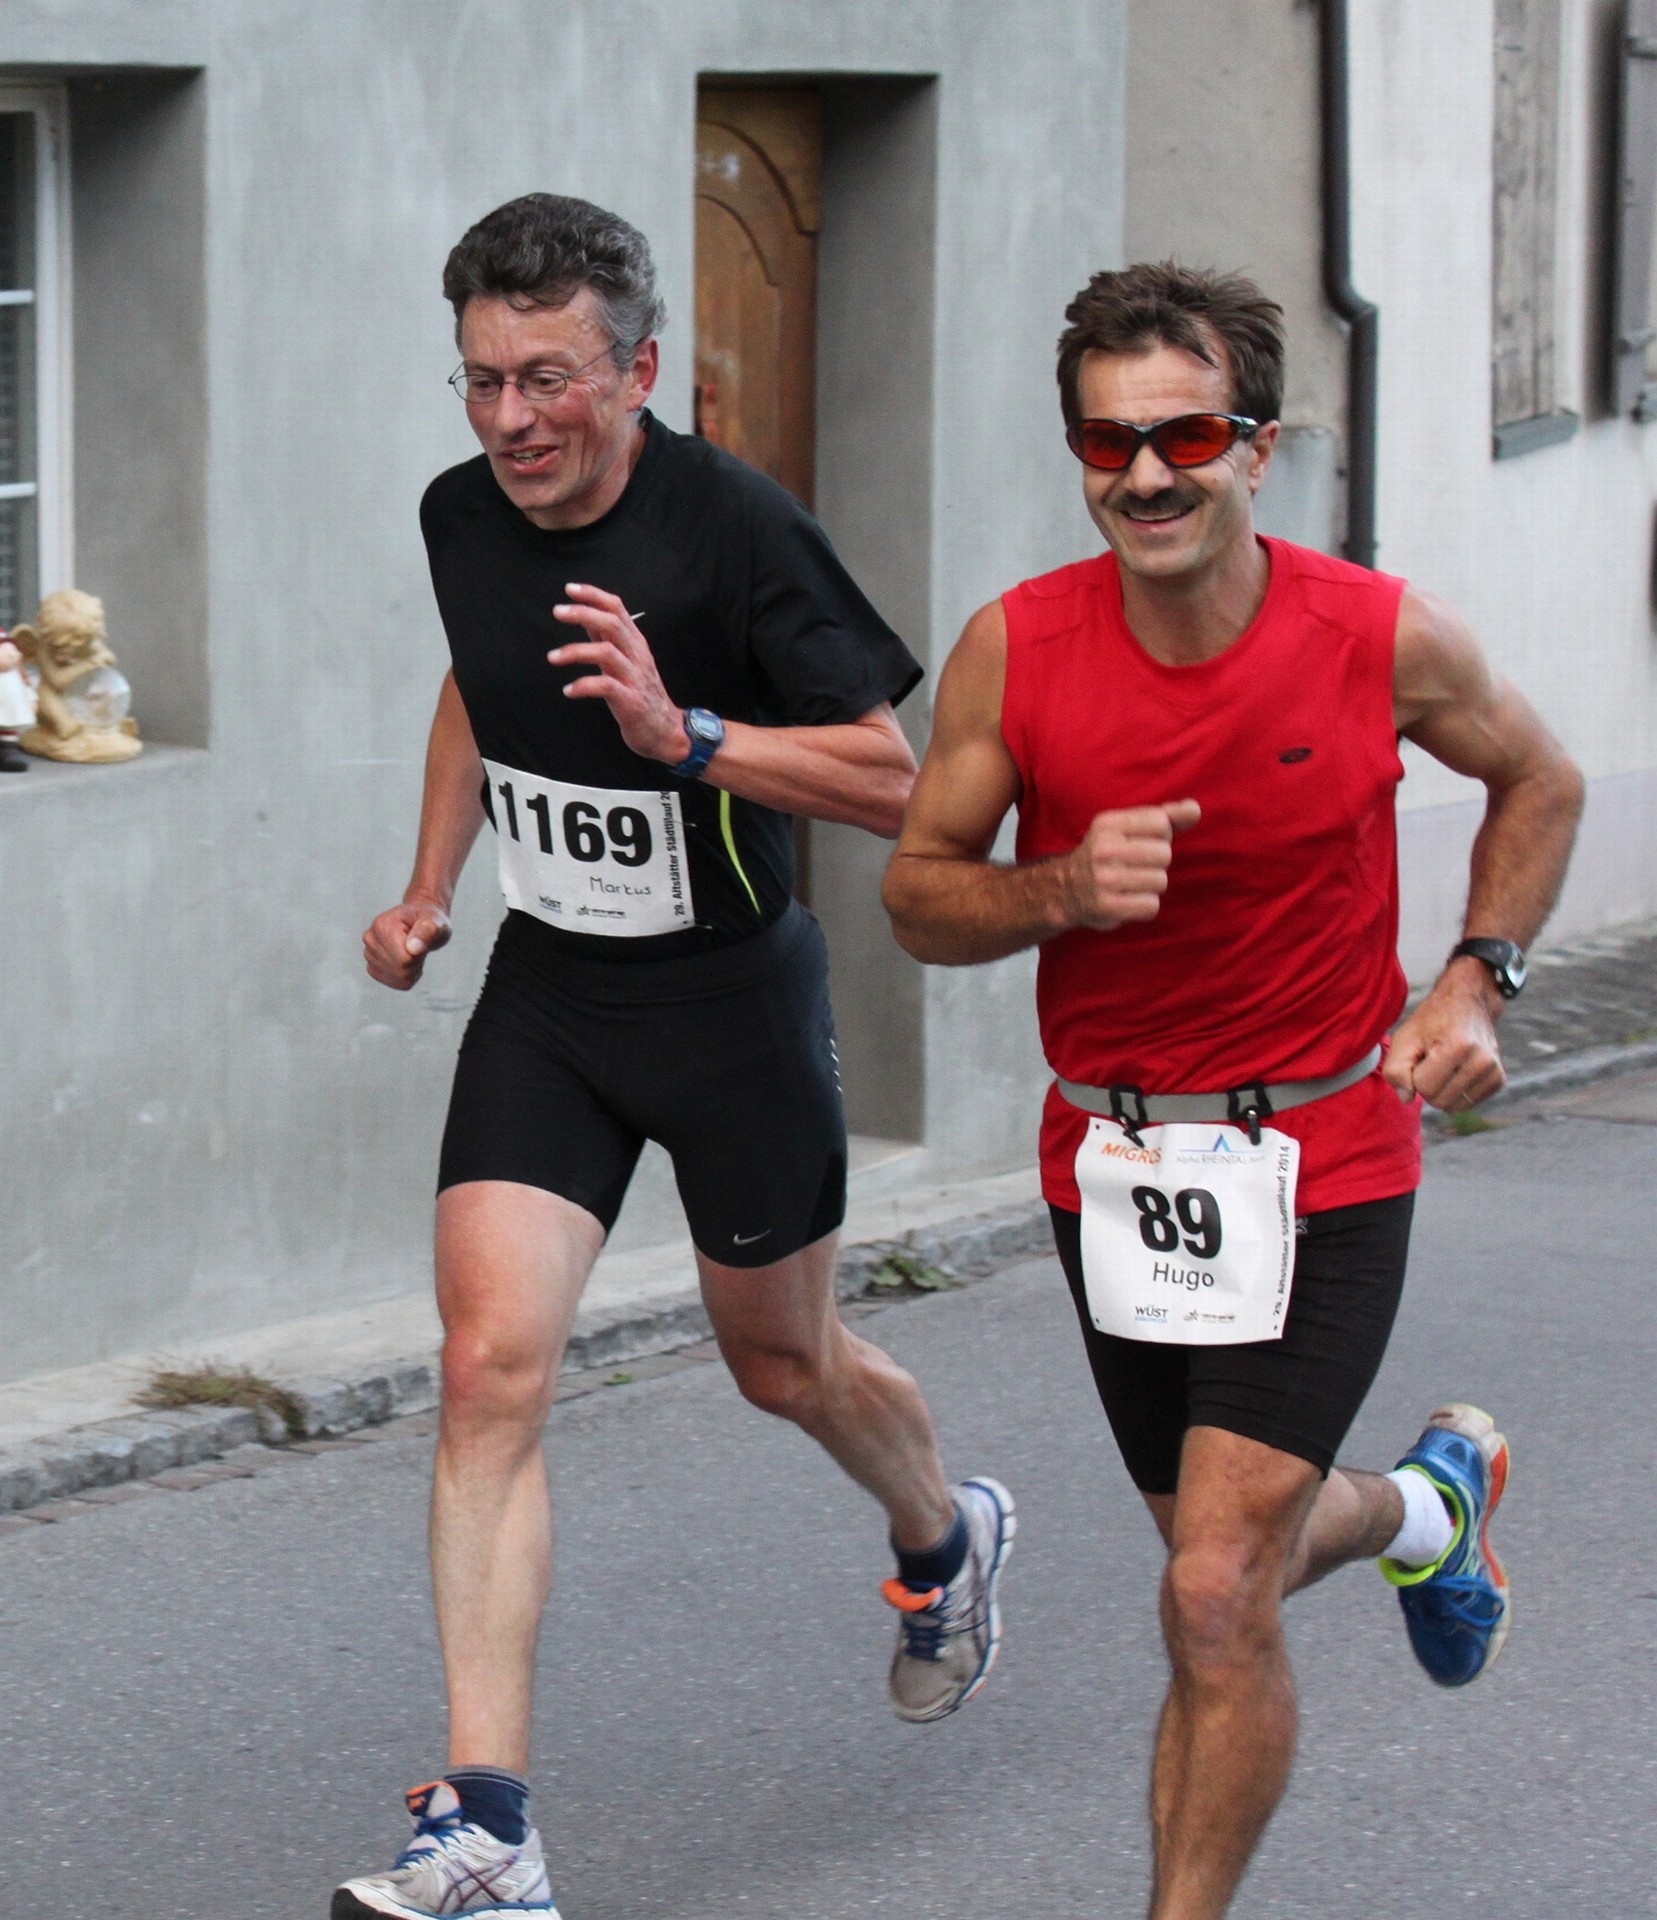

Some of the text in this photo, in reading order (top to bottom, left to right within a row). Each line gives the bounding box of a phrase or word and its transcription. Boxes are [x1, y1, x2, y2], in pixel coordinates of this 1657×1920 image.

[498, 780, 652, 868] 1169
[589, 876, 652, 896] Markus
[1131, 1185, 1222, 1260] 89
[1153, 1262, 1215, 1291] Hugo
[1135, 1303, 1168, 1317] WÜST
